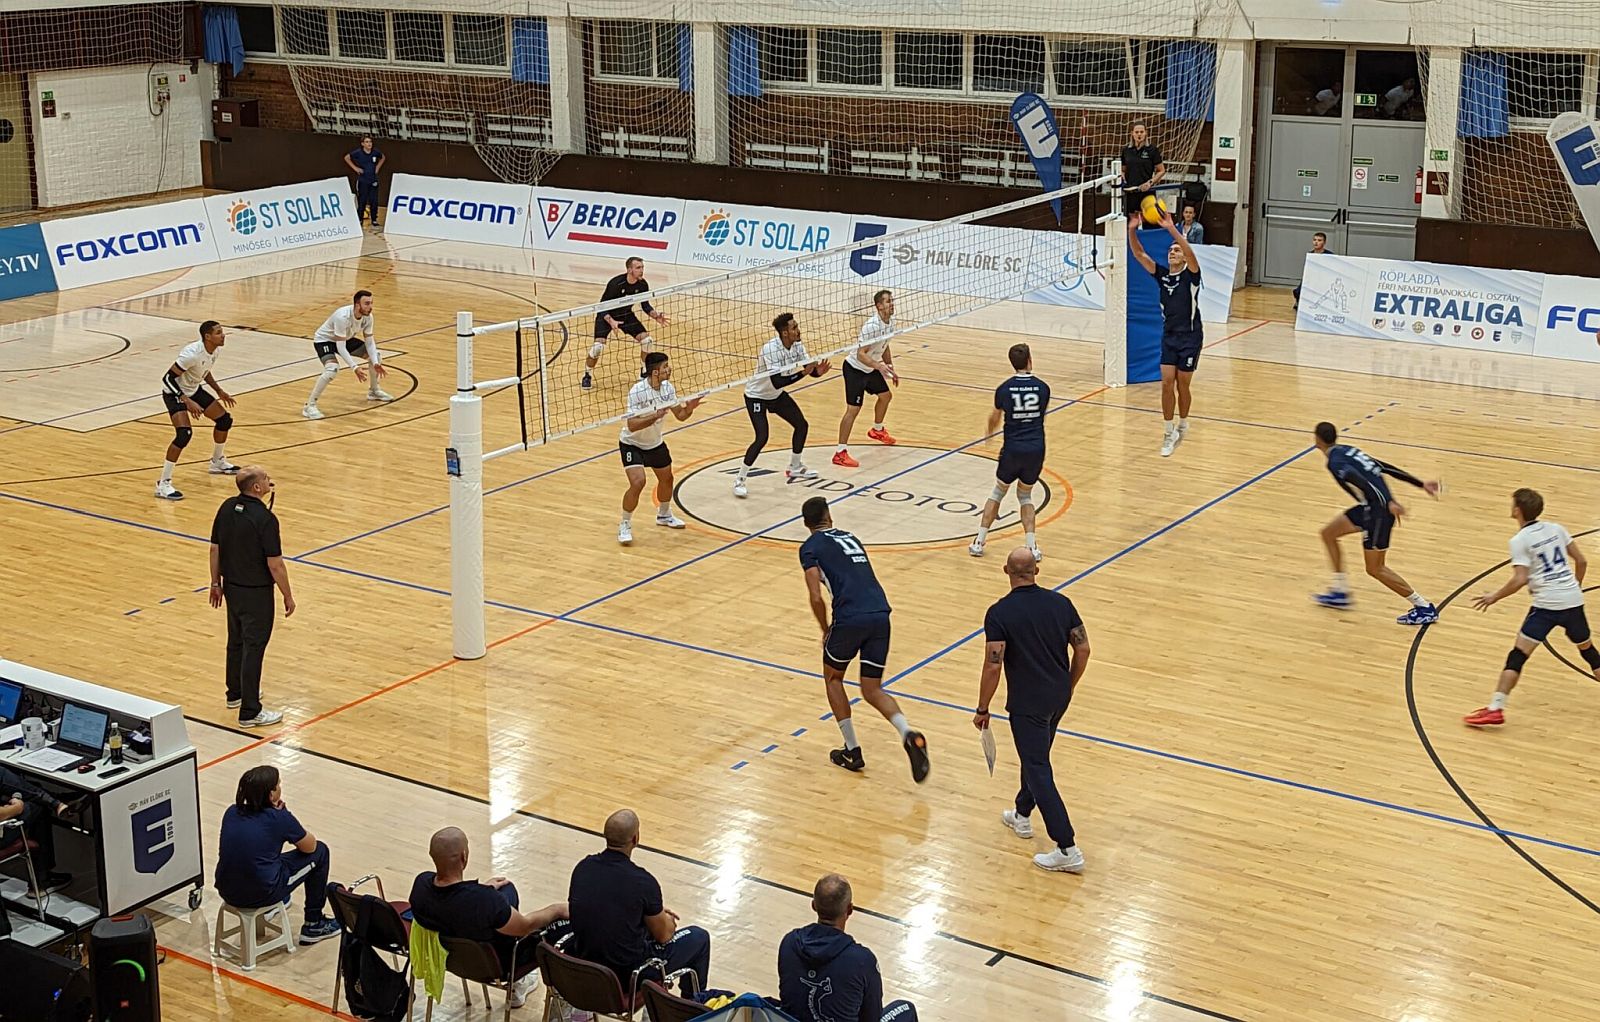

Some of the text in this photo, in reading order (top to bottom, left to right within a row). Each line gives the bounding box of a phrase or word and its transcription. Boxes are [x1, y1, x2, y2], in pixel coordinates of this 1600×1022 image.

[259, 193, 343, 229] ST SOLAR
[547, 203, 560, 222] B
[572, 202, 677, 233] BERICAP
[733, 219, 830, 252] ST SOLAR
[925, 247, 1022, 273] MÁV ELŐRE SC
[1380, 268, 1441, 286] RÖPLABDA
[1398, 284, 1431, 295] NEMZETI
[1433, 287, 1478, 299] BAJNOKSÁG
[1374, 291, 1523, 328] EXTRALIGA
[1011, 393, 1040, 411] 12
[626, 451, 633, 462] 8
[833, 536, 864, 555] 11
[1537, 546, 1566, 573] 14
